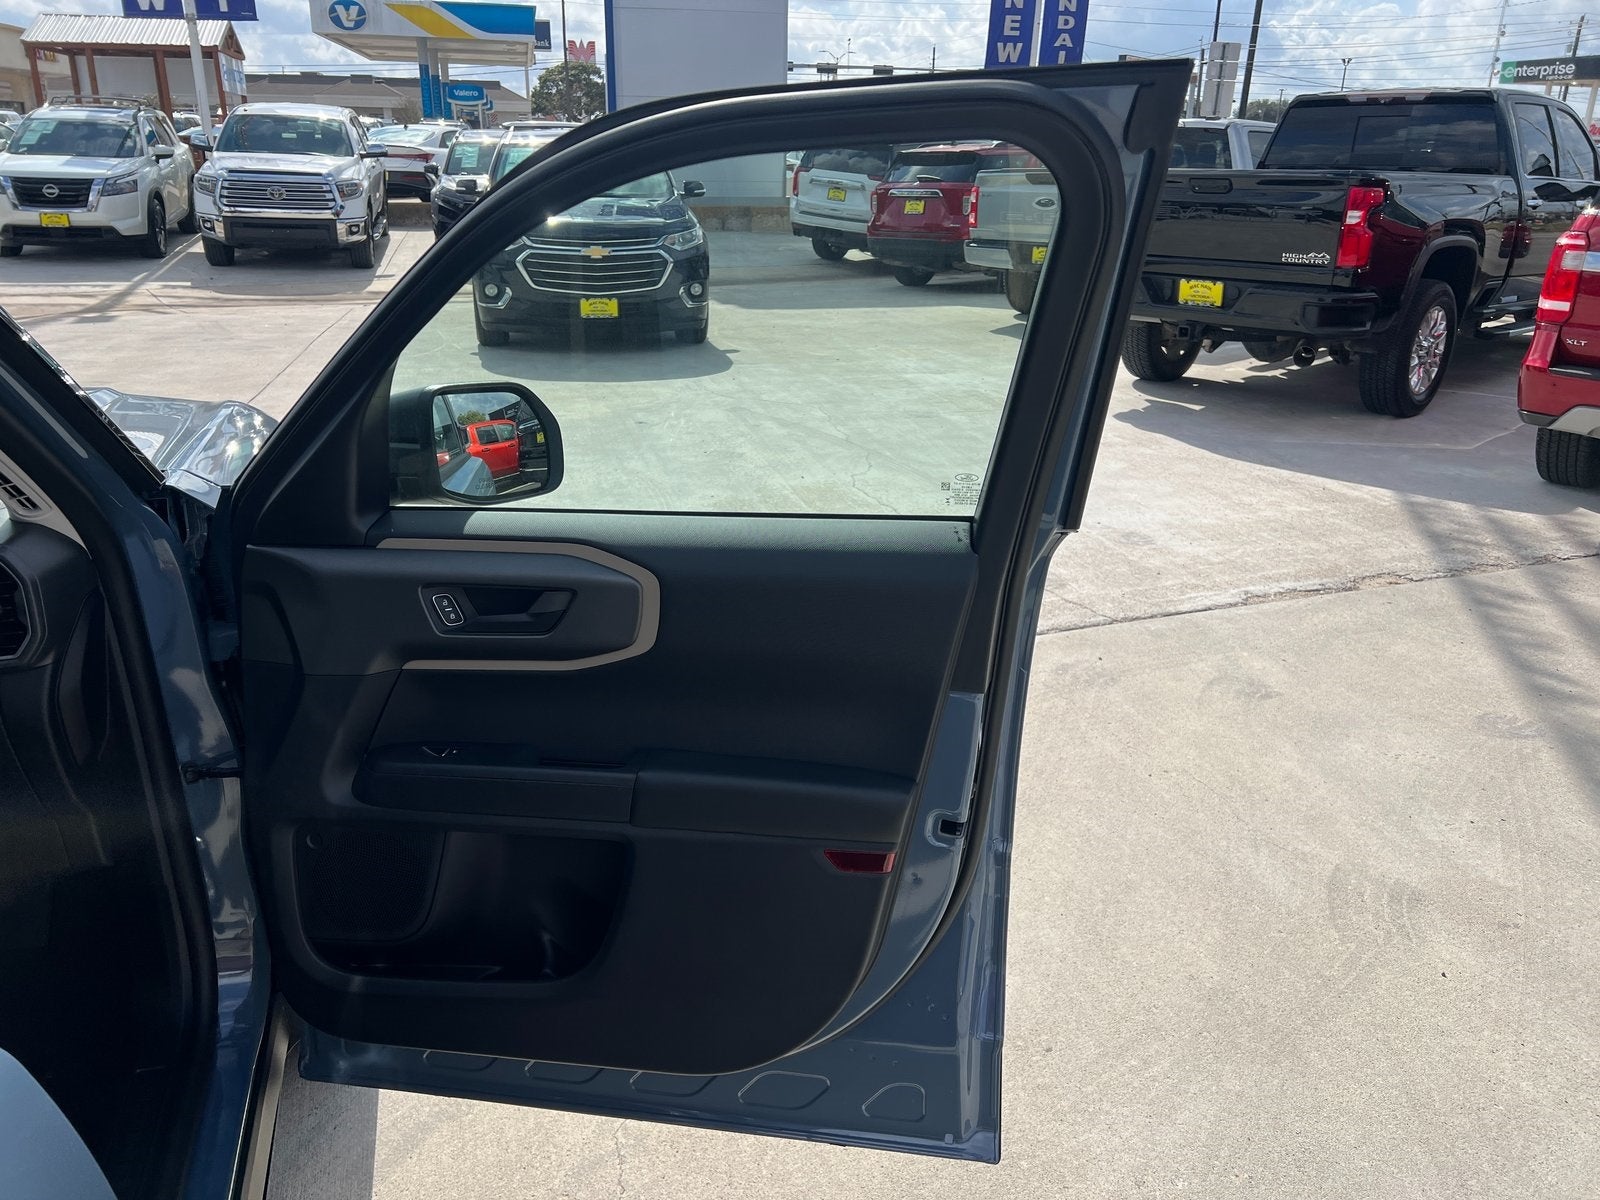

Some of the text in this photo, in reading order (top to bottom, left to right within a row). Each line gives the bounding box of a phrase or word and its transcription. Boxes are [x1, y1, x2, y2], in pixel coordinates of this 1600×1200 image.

[1500, 61, 1576, 79] enterprise
[453, 89, 479, 97] Valero
[1566, 338, 1588, 347] XLT
